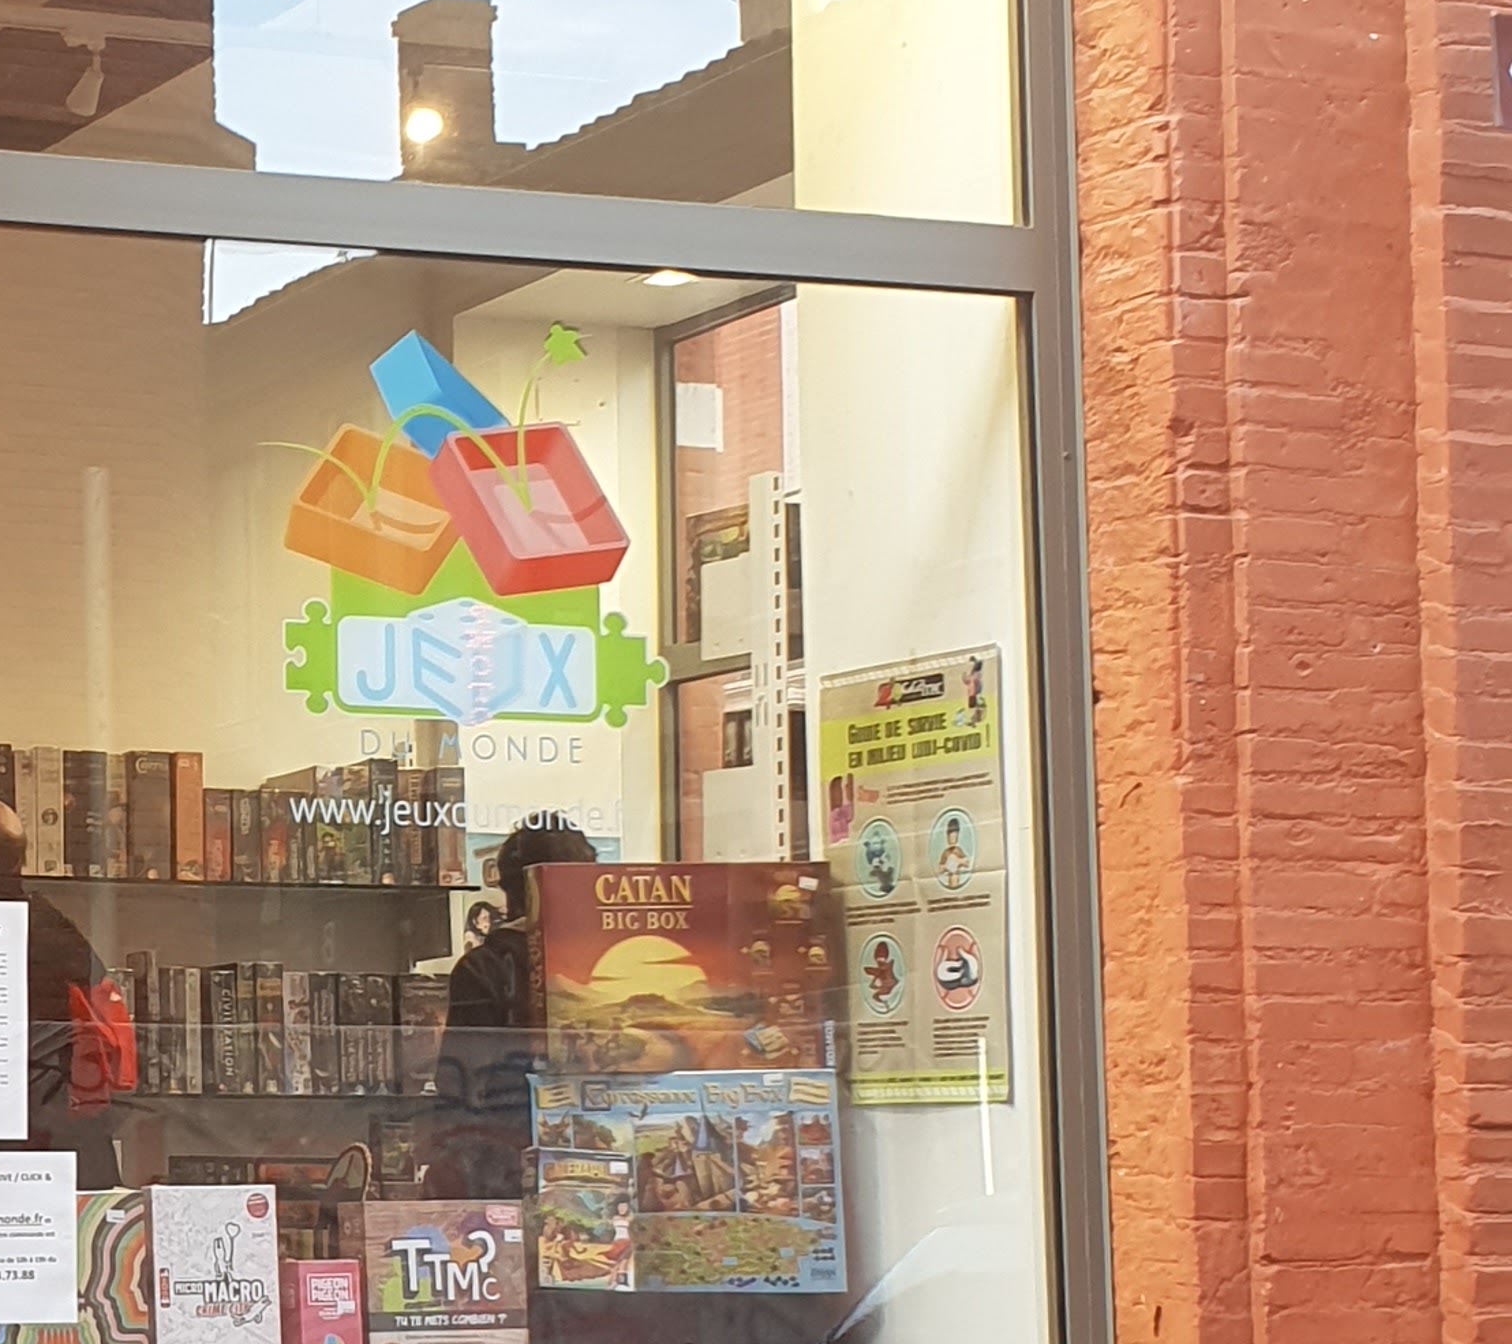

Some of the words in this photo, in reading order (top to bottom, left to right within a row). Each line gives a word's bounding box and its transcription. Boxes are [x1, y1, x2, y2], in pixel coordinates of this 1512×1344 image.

[356, 623, 577, 718] JEUX
[361, 729, 410, 758] DU
[439, 732, 583, 763] MONDE
[595, 874, 692, 904] CATAN
[601, 912, 639, 930] BIG
[646, 912, 690, 930] BOX
[21, 1172, 42, 1182] CLICK
[203, 1279, 263, 1304] MACRO
